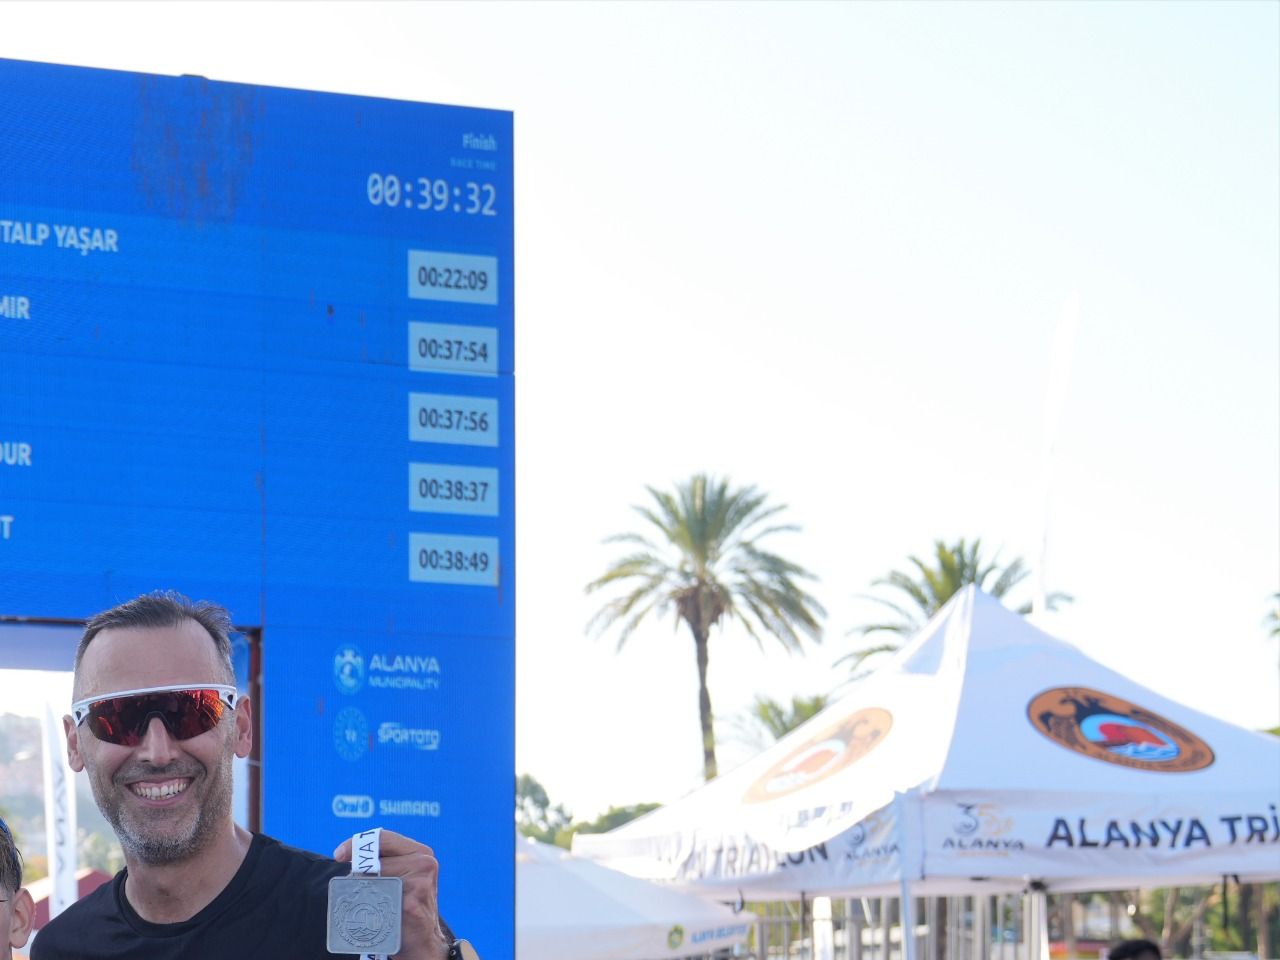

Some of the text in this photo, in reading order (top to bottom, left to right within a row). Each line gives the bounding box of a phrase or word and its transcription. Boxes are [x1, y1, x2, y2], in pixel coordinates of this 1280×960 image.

[462, 133, 497, 151] Finish
[366, 172, 497, 217] 00:39:32
[53, 223, 119, 257] YAŞAR
[418, 265, 489, 292] 00:22:09
[418, 337, 489, 363] 00:37:54
[418, 407, 489, 433] 00:37:56
[418, 477, 489, 503] 00:38:37
[418, 548, 489, 573] 00:38:49
[369, 653, 441, 674] ALANYA
[368, 675, 440, 690] MUNICIPALITY
[379, 800, 441, 818] SHIMANO
[1046, 817, 1213, 849] ALANYA
[1220, 803, 1280, 845] TRİ
[942, 837, 1025, 850] ALANYA
